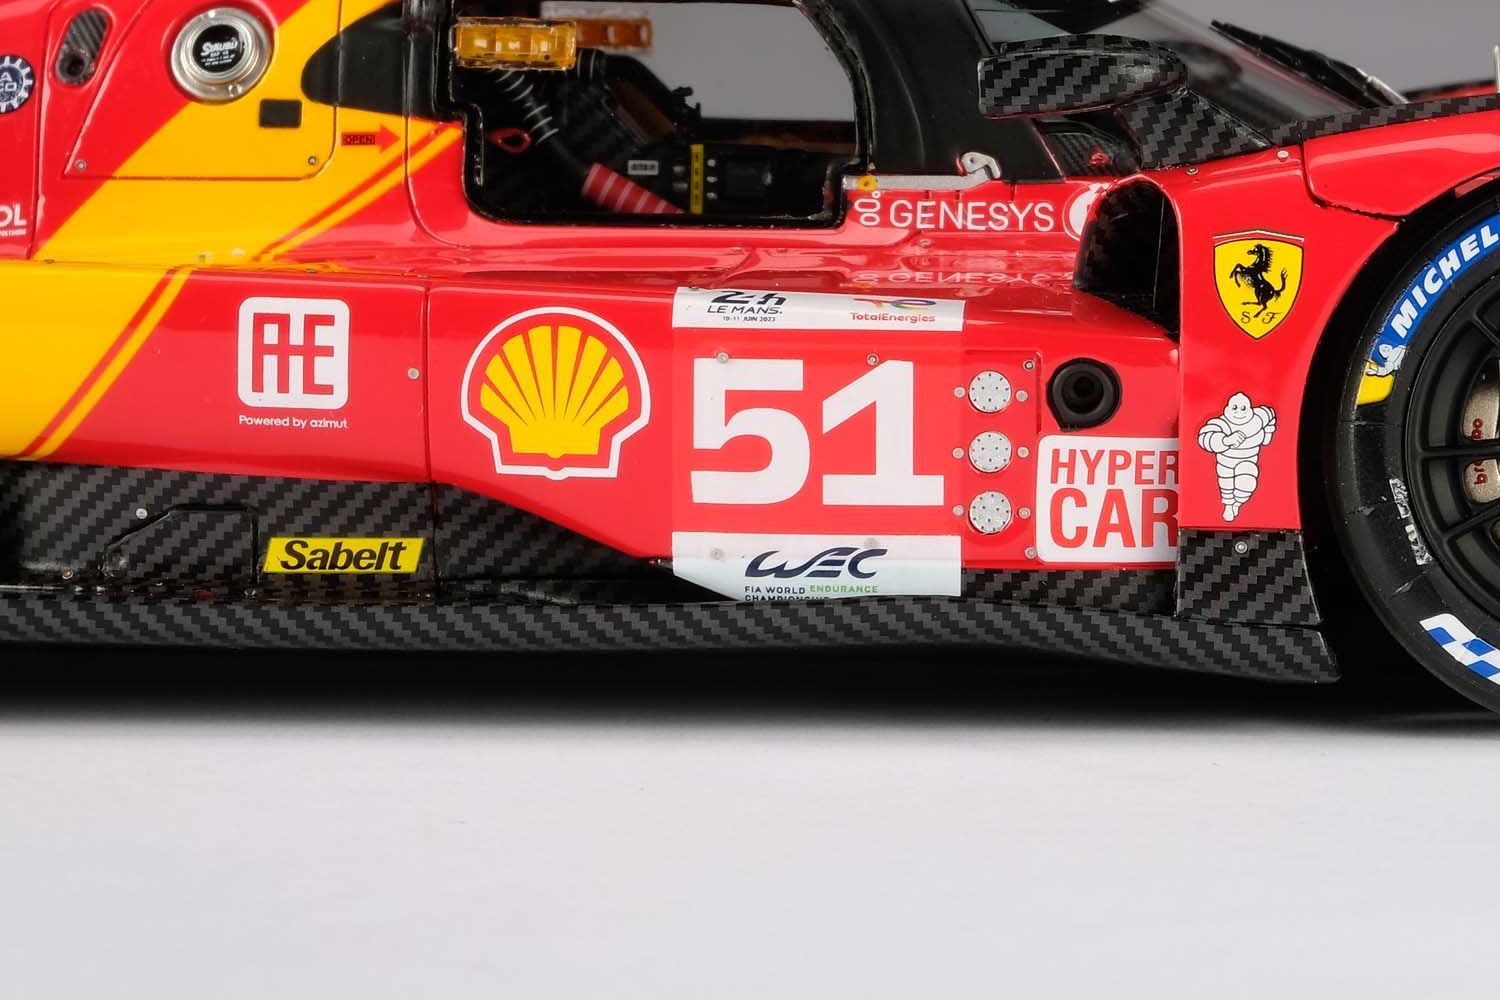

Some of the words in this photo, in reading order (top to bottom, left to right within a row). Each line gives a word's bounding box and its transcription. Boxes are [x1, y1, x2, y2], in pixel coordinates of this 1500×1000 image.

[889, 199, 1055, 232] GENESYS
[707, 305, 728, 314] LE
[850, 312, 935, 324] TotalEnergies
[1240, 311, 1252, 325] S
[239, 414, 290, 427] Powered
[292, 416, 307, 430] by
[310, 417, 348, 429] azimut
[690, 358, 945, 506] 51
[1050, 448, 1179, 486] HYPER
[1049, 487, 1179, 551] CAR
[280, 539, 408, 572] Sabelt
[744, 585, 762, 594] FIA
[765, 586, 806, 595] WORLD
[809, 584, 879, 594] ENDURANCE
